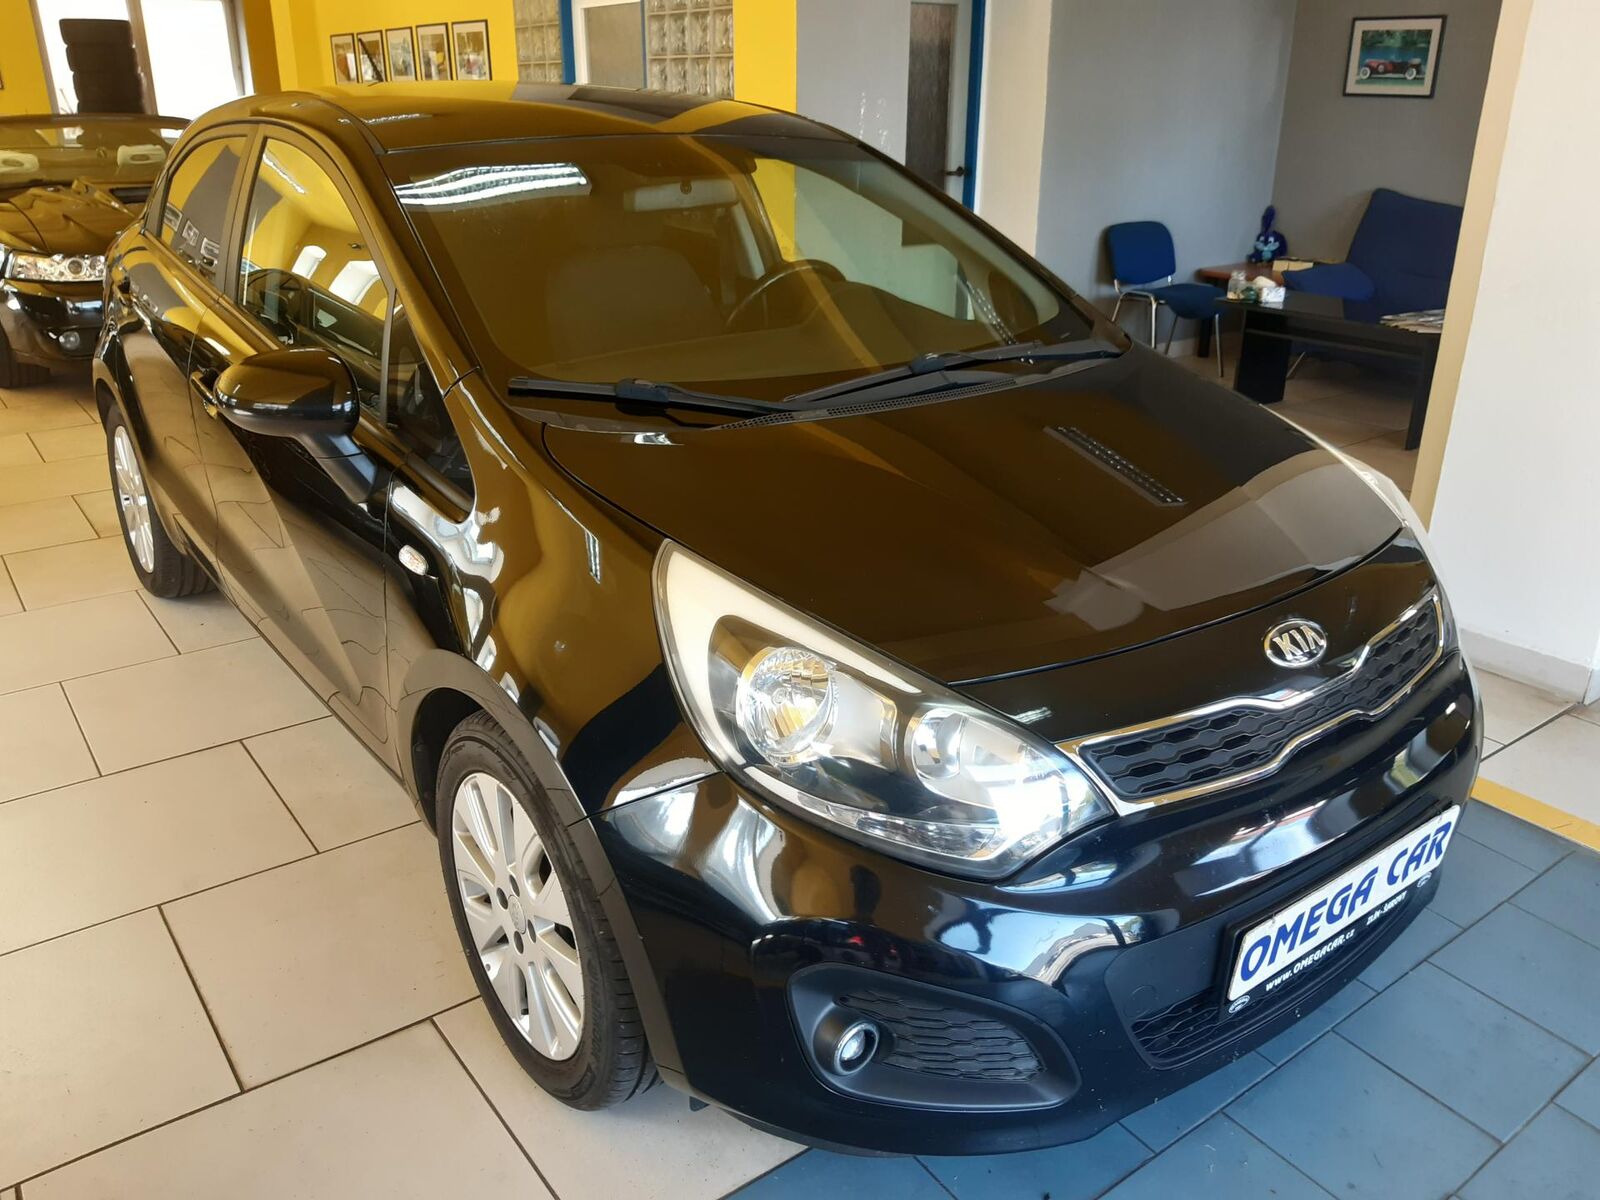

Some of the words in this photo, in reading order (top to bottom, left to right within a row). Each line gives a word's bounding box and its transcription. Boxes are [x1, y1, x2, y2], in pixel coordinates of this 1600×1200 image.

[1272, 625, 1325, 660] KIA
[1240, 866, 1379, 982] OMEGA
[1387, 821, 1452, 886] CAR
